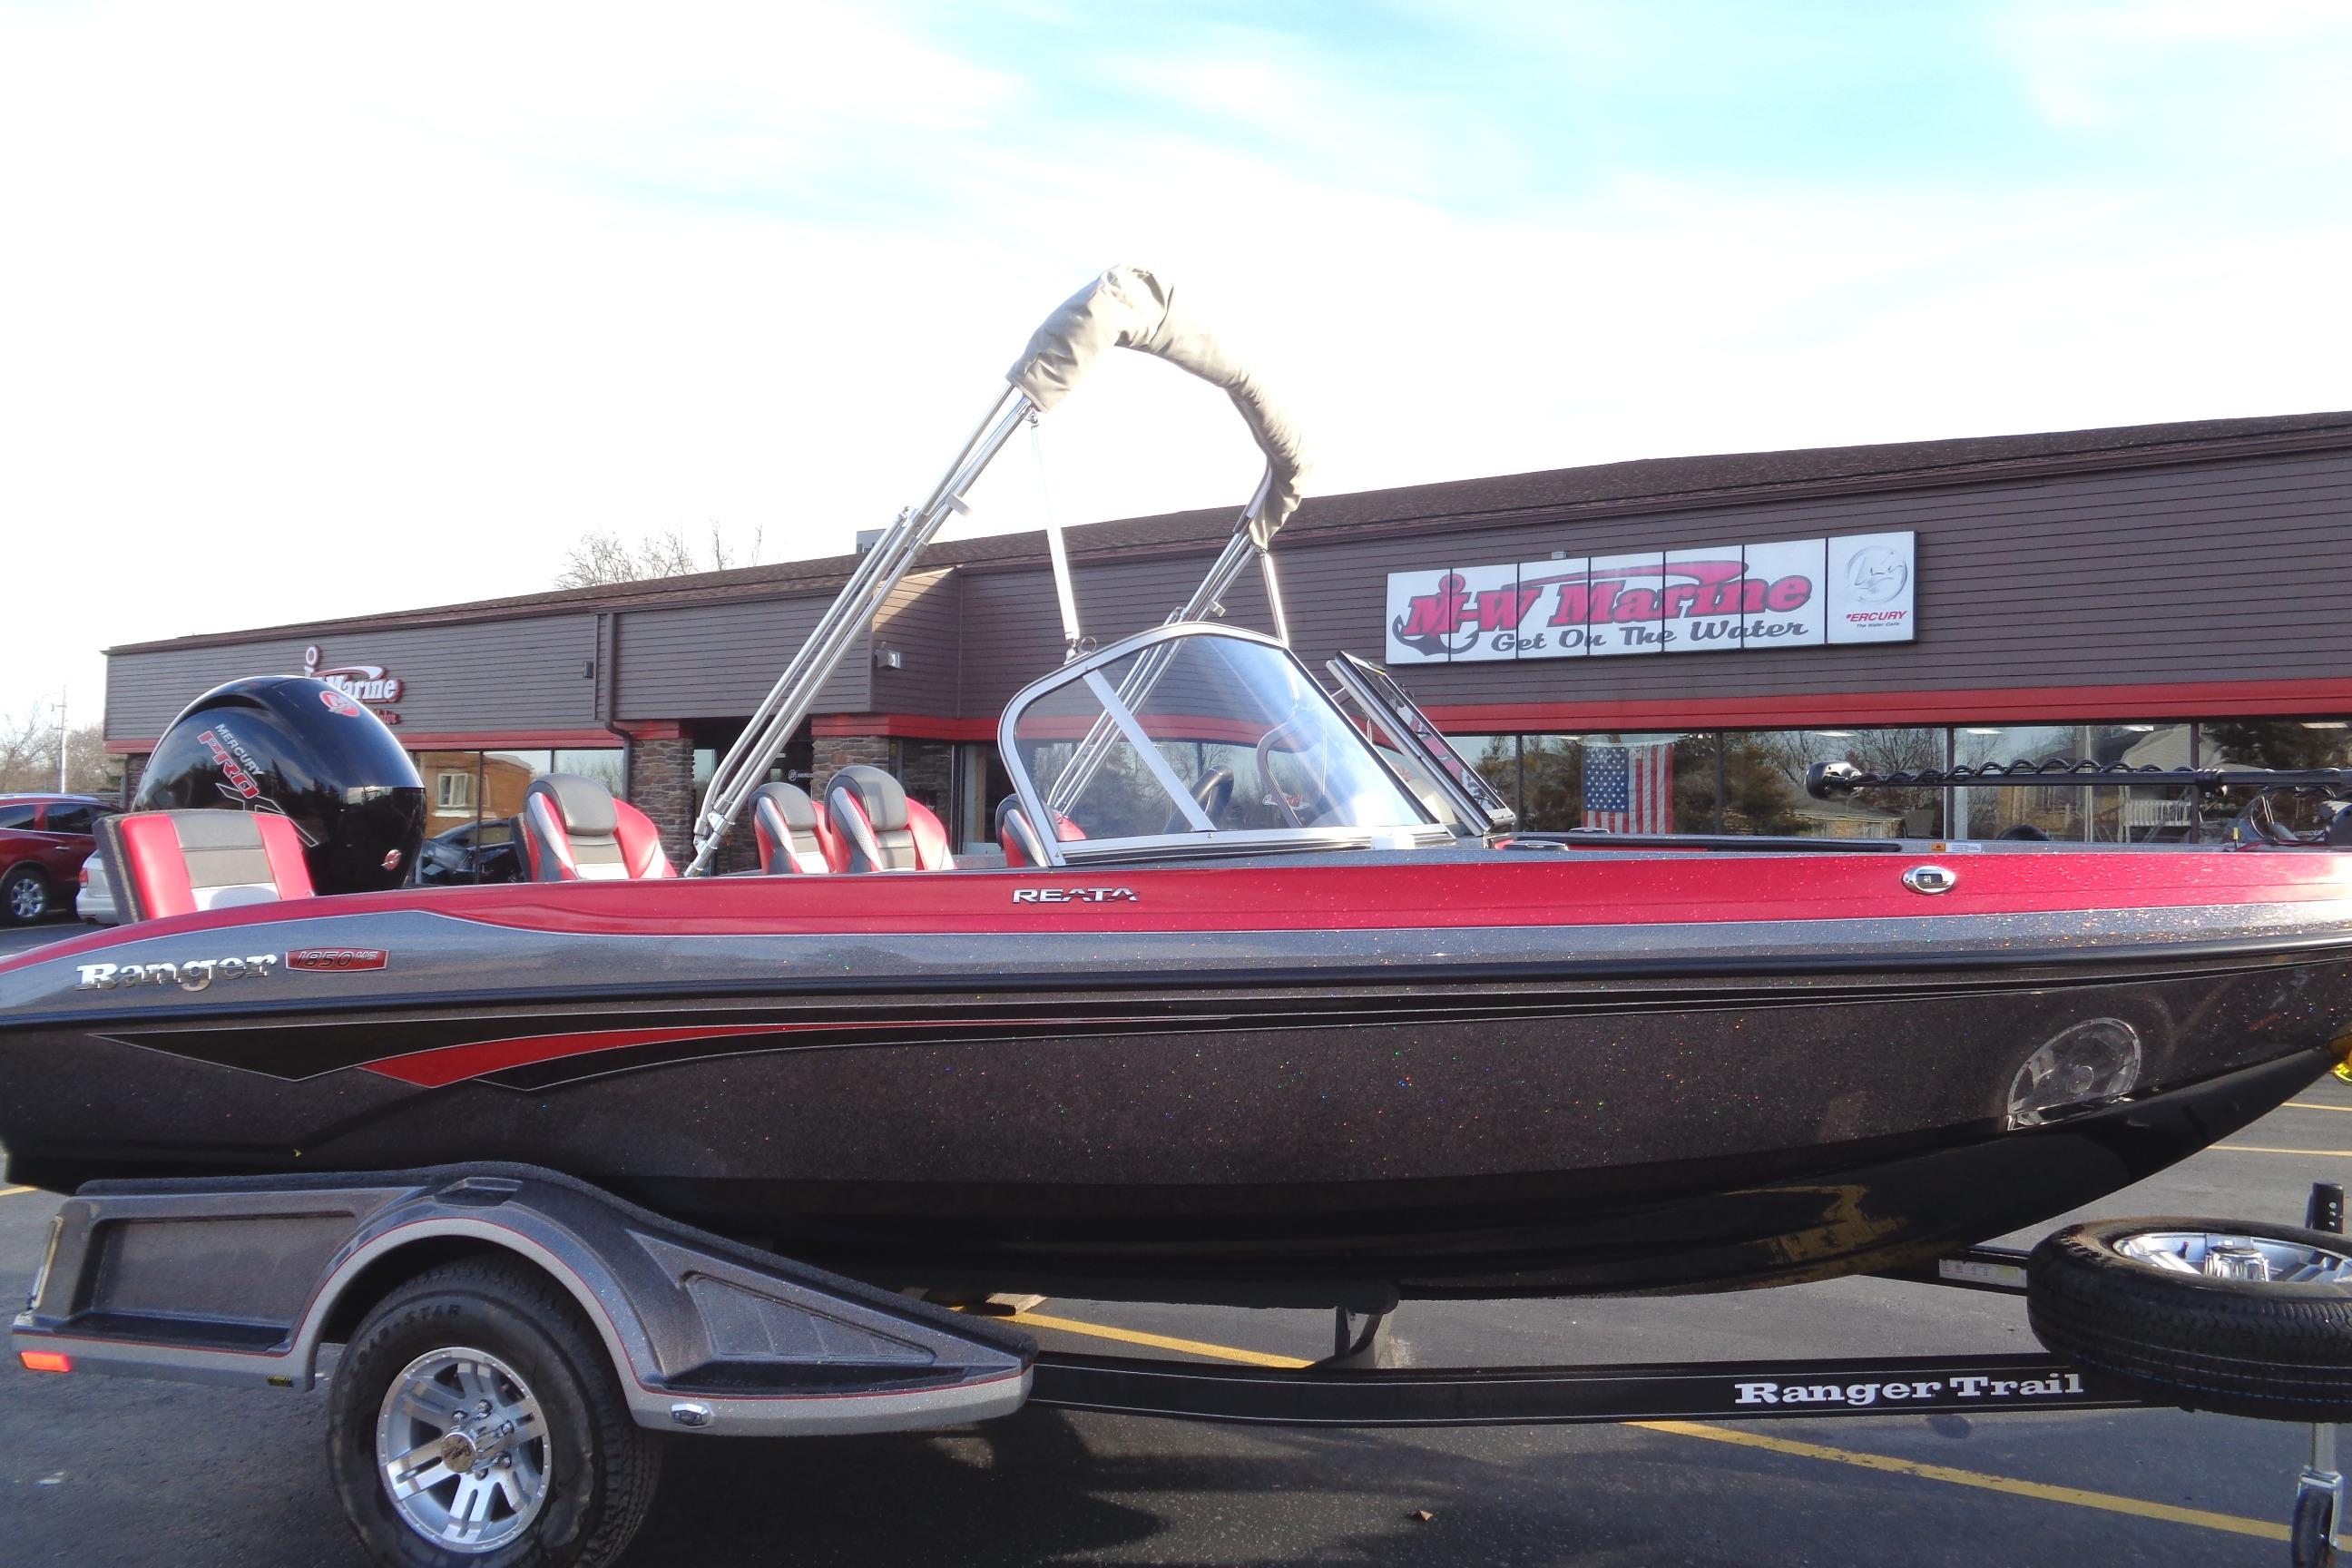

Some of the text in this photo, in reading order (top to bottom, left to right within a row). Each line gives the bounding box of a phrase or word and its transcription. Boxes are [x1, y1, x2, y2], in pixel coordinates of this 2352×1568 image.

[1546, 561, 1813, 628] Marine
[1846, 610, 1907, 622] ERCURY
[1491, 620, 1808, 652] Get On The Water
[197, 730, 260, 799] PRO
[215, 723, 265, 775] MERCURY
[1013, 887, 1140, 904] REATA
[74, 953, 279, 992] Ranger
[1734, 1373, 2084, 1406] Ranger Trail
